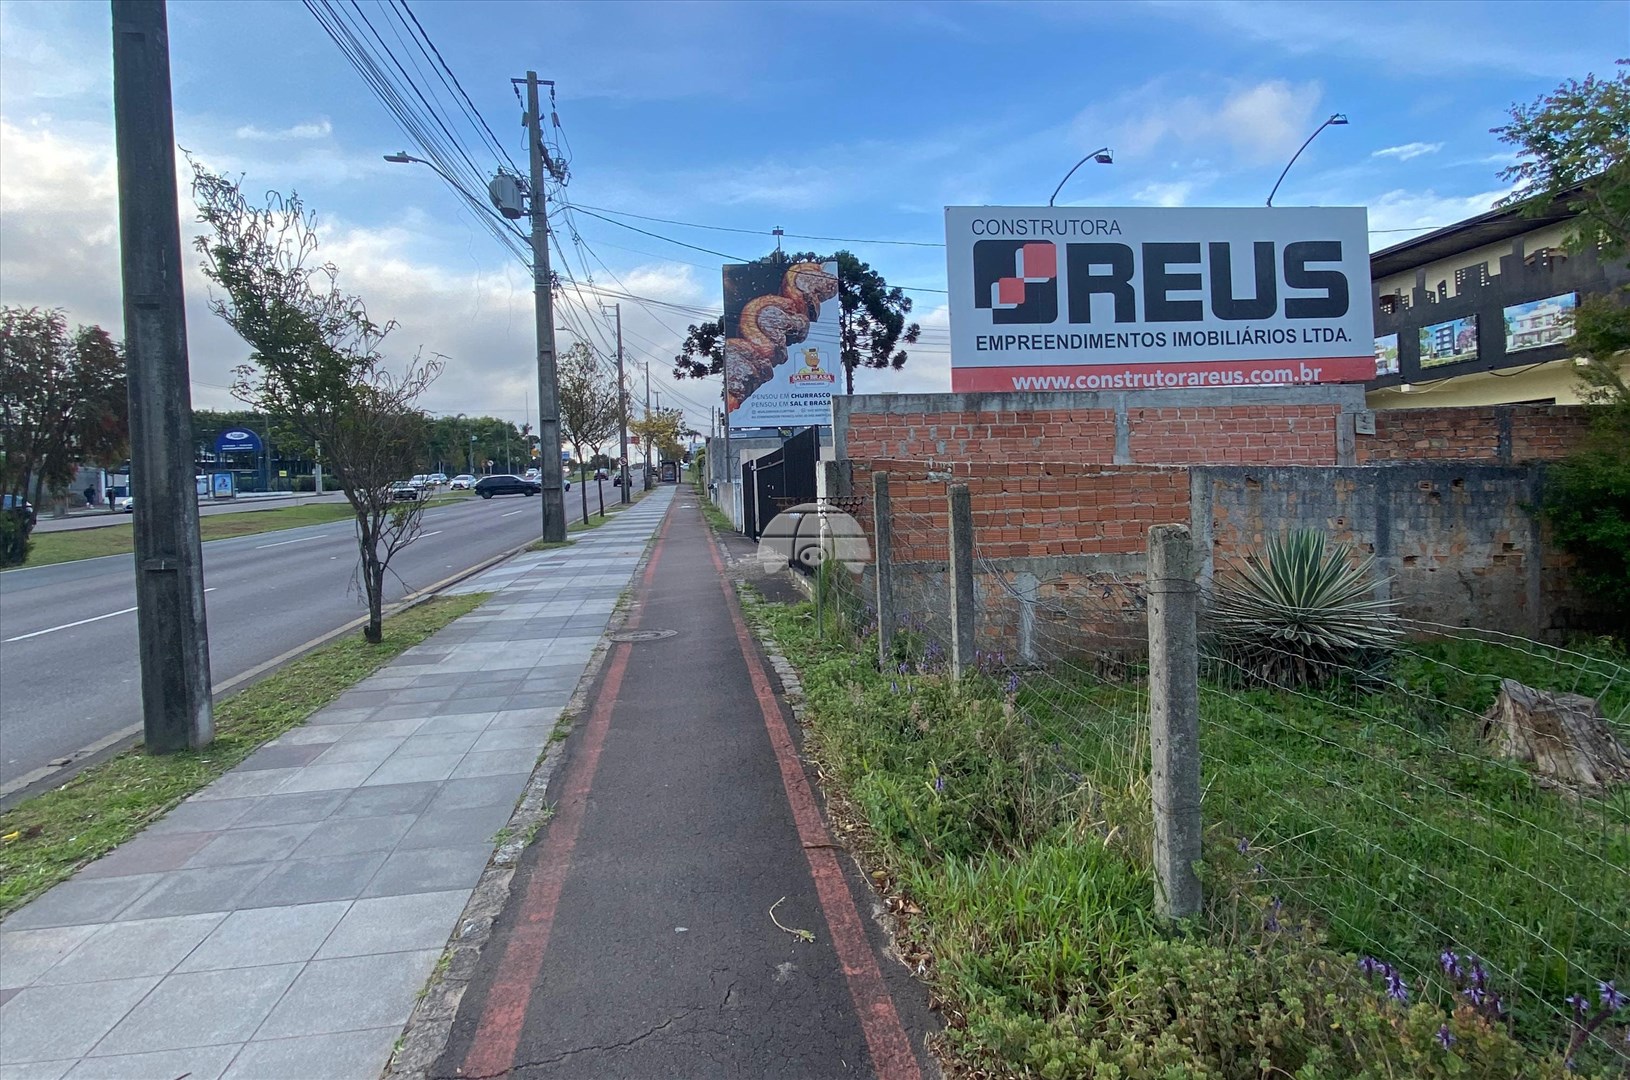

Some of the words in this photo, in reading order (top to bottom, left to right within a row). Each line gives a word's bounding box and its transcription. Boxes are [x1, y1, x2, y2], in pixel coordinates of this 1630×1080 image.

[971, 218, 1122, 236] CONSTRUTORA
[976, 331, 1166, 351] EMPREENDIMENTOS
[1173, 325, 1297, 347] IMOBILIÁRIOS
[1303, 327, 1352, 344] LTDA.
[1012, 362, 1322, 390] www.construtorareus.com.br
